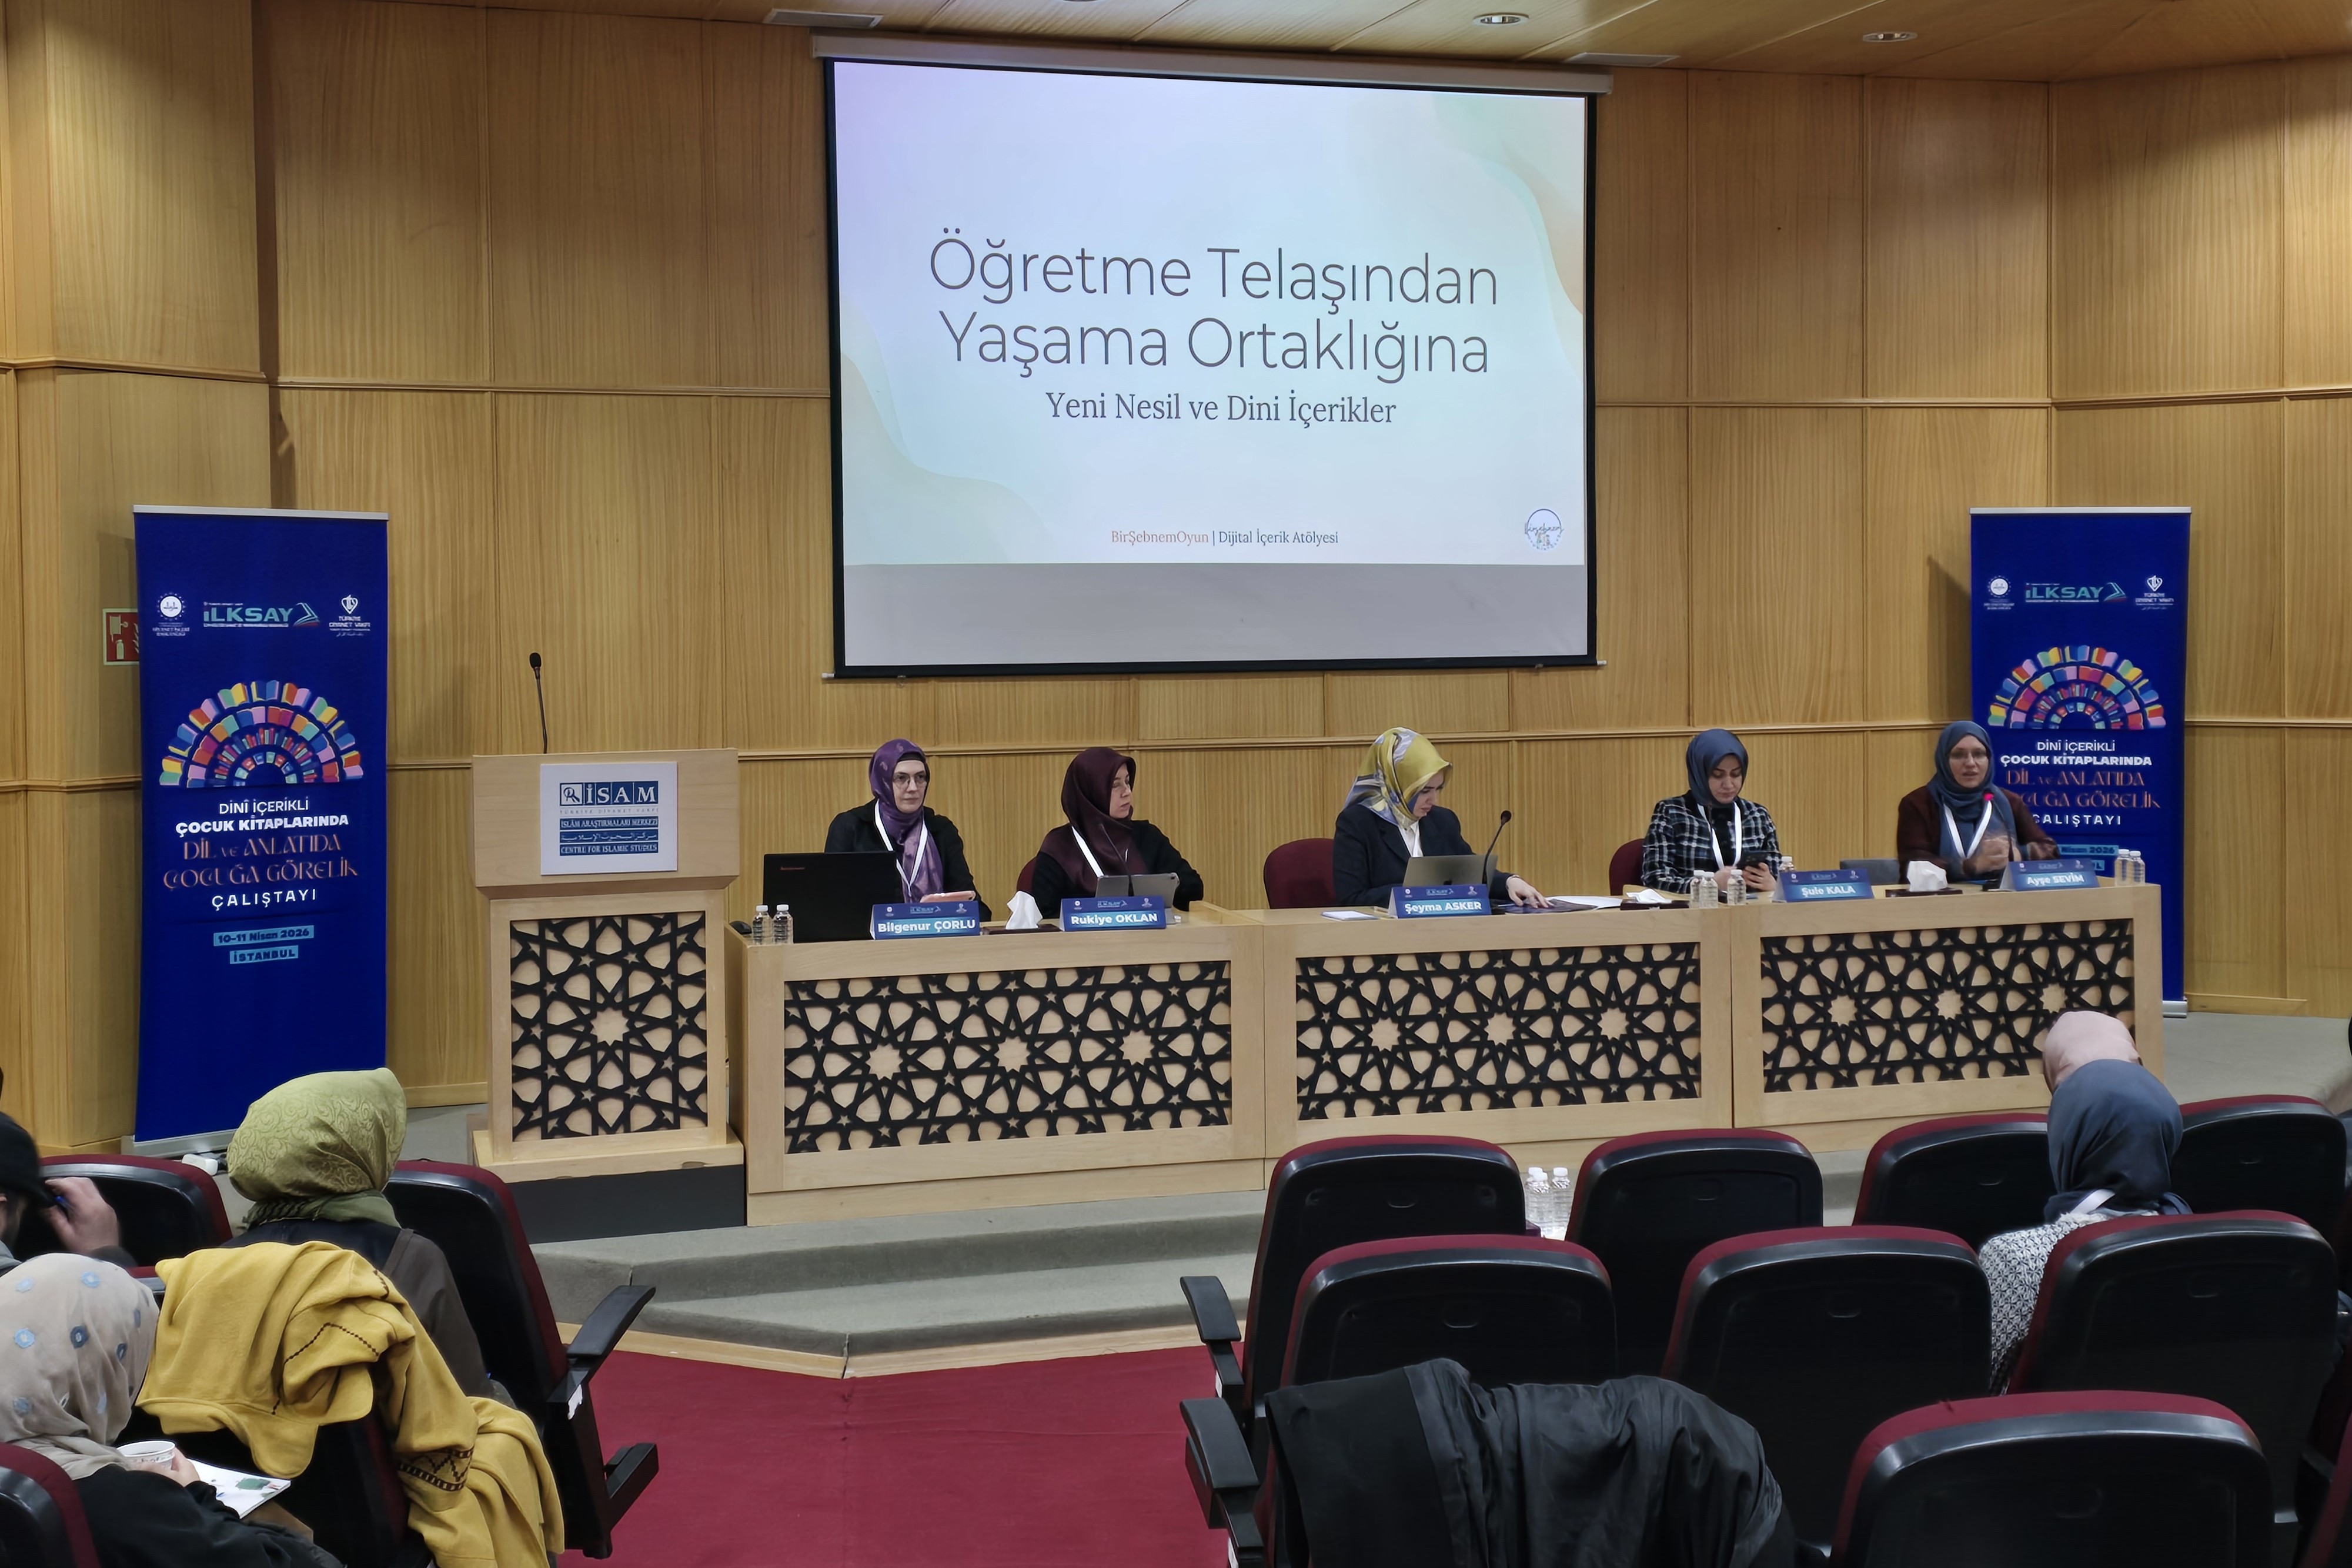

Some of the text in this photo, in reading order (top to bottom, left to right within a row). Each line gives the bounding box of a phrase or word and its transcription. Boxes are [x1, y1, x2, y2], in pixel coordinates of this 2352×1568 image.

[930, 227, 1496, 315] Öğretme Telaşından
[938, 310, 1488, 384] Yaşama Ortaklığına
[1045, 389, 1396, 429] Yeni Nesil ve Dini İçerikler
[1111, 530, 1209, 546] BirŞebnemOyun
[1218, 530, 1252, 546] Dijital
[1256, 528, 1290, 546] İçerik
[1292, 531, 1339, 547] Atölyesi
[2065, 739, 2116, 754] İÇERİKLİ
[2000, 753, 2152, 767] ÇOCUK KİTAPLARINDA
[2006, 768, 2035, 785] DİL
[2057, 771, 2145, 786] ANLATIDA
[252, 796, 309, 816] İÇERİKLİ
[2076, 790, 2161, 809] GÖRELİK
[175, 814, 349, 838] ÇOCUK KİTAPLARINDA
[183, 837, 216, 860] DİL
[243, 833, 342, 857] ANLATIDA
[163, 856, 359, 892] ÇOCUĞA GÖRELİK
[211, 888, 317, 911] ÇALIŞTAYI
[1826, 885, 1856, 895] KALA
[1404, 901, 1482, 915] Şeyma ASKER
[877, 919, 976, 934] Bilgenur ÇORLU
[1071, 913, 1158, 926] Rukiye OKLAN
[249, 931, 278, 941] Nisan
[280, 928, 310, 938] 2026
[233, 949, 296, 962] İSTANBUL
